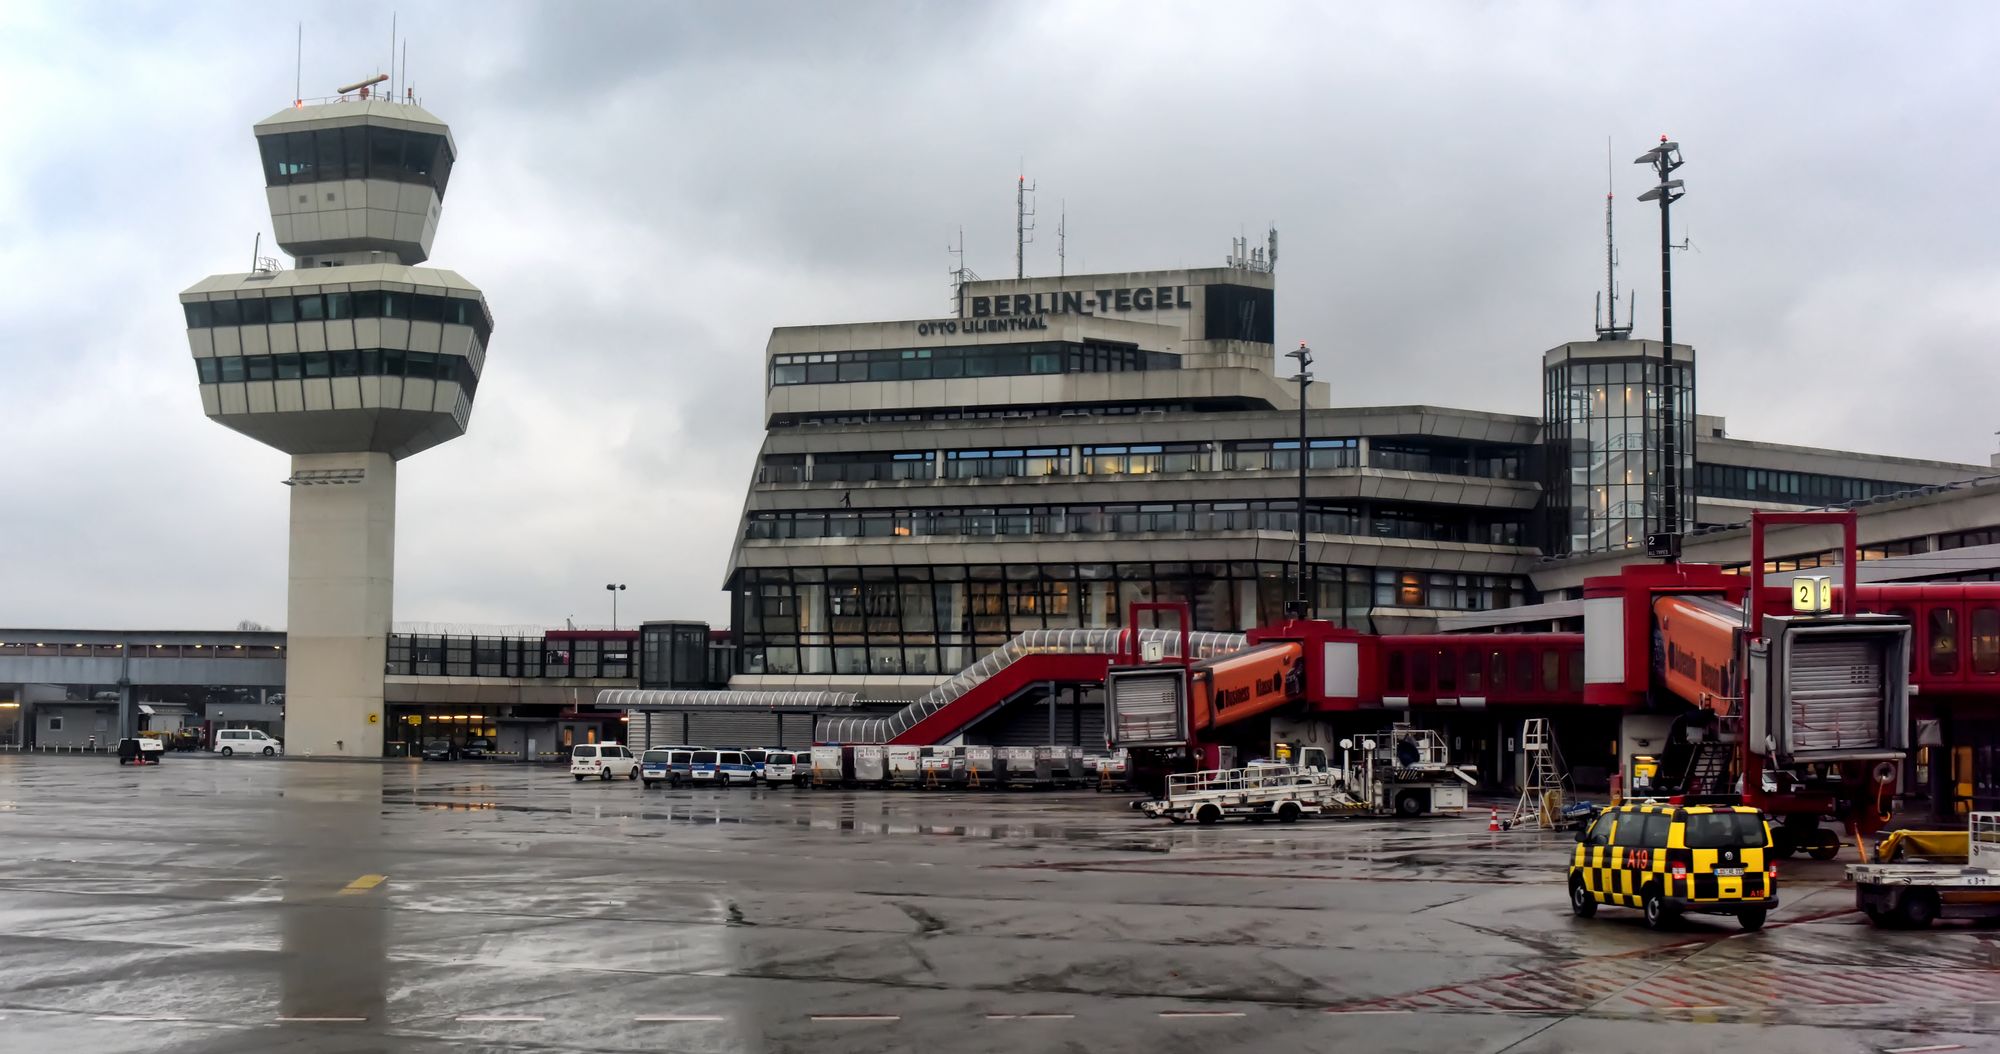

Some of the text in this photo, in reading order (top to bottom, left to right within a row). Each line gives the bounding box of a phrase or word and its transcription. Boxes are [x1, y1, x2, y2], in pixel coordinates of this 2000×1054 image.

[972, 287, 1191, 317] BERLIN-TEGEL
[918, 313, 1048, 336] OTTO LILIENTHAL
[1649, 536, 1655, 546] 2
[1799, 585, 1809, 603] 2
[1822, 585, 1827, 603] 2
[1152, 646, 1157, 657] 1
[1225, 678, 1273, 708] Business Klasse
[370, 714, 376, 723] C
[1627, 848, 1649, 869] A19
[1750, 889, 1764, 897] A19
